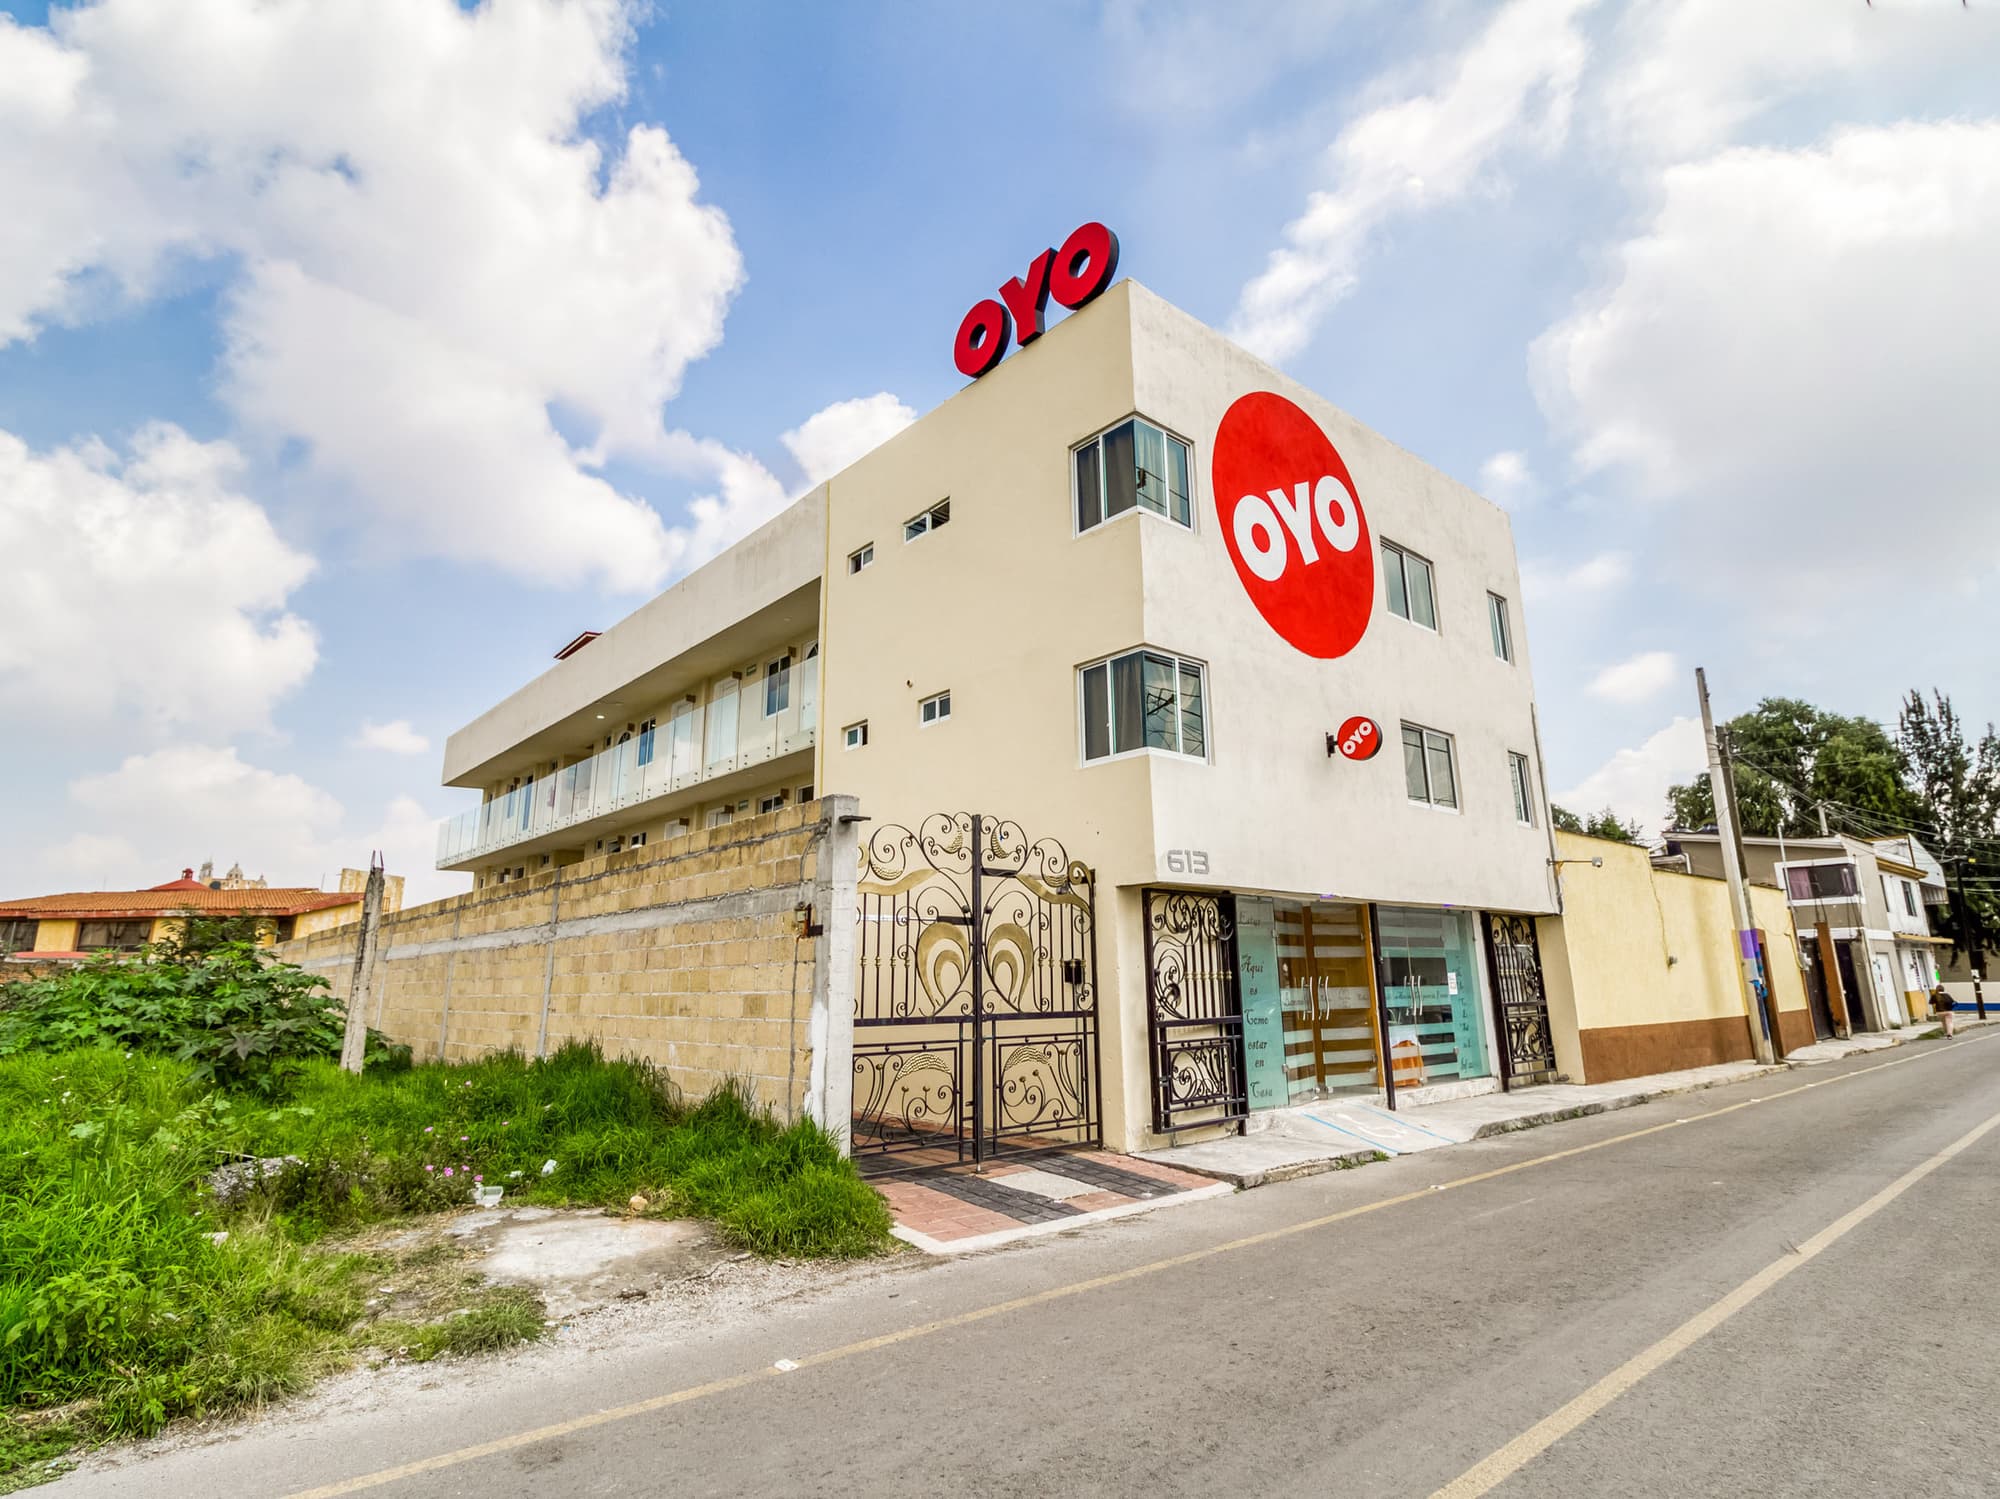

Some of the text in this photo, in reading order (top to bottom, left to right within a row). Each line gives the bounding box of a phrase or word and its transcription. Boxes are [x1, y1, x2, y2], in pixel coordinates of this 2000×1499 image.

[954, 222, 1120, 379] OYO
[1233, 475, 1360, 582] OYO
[1342, 721, 1373, 755] OYO
[1167, 849, 1210, 875] 613
[1248, 1040, 1268, 1050] estar
[1254, 1059, 1265, 1068] en
